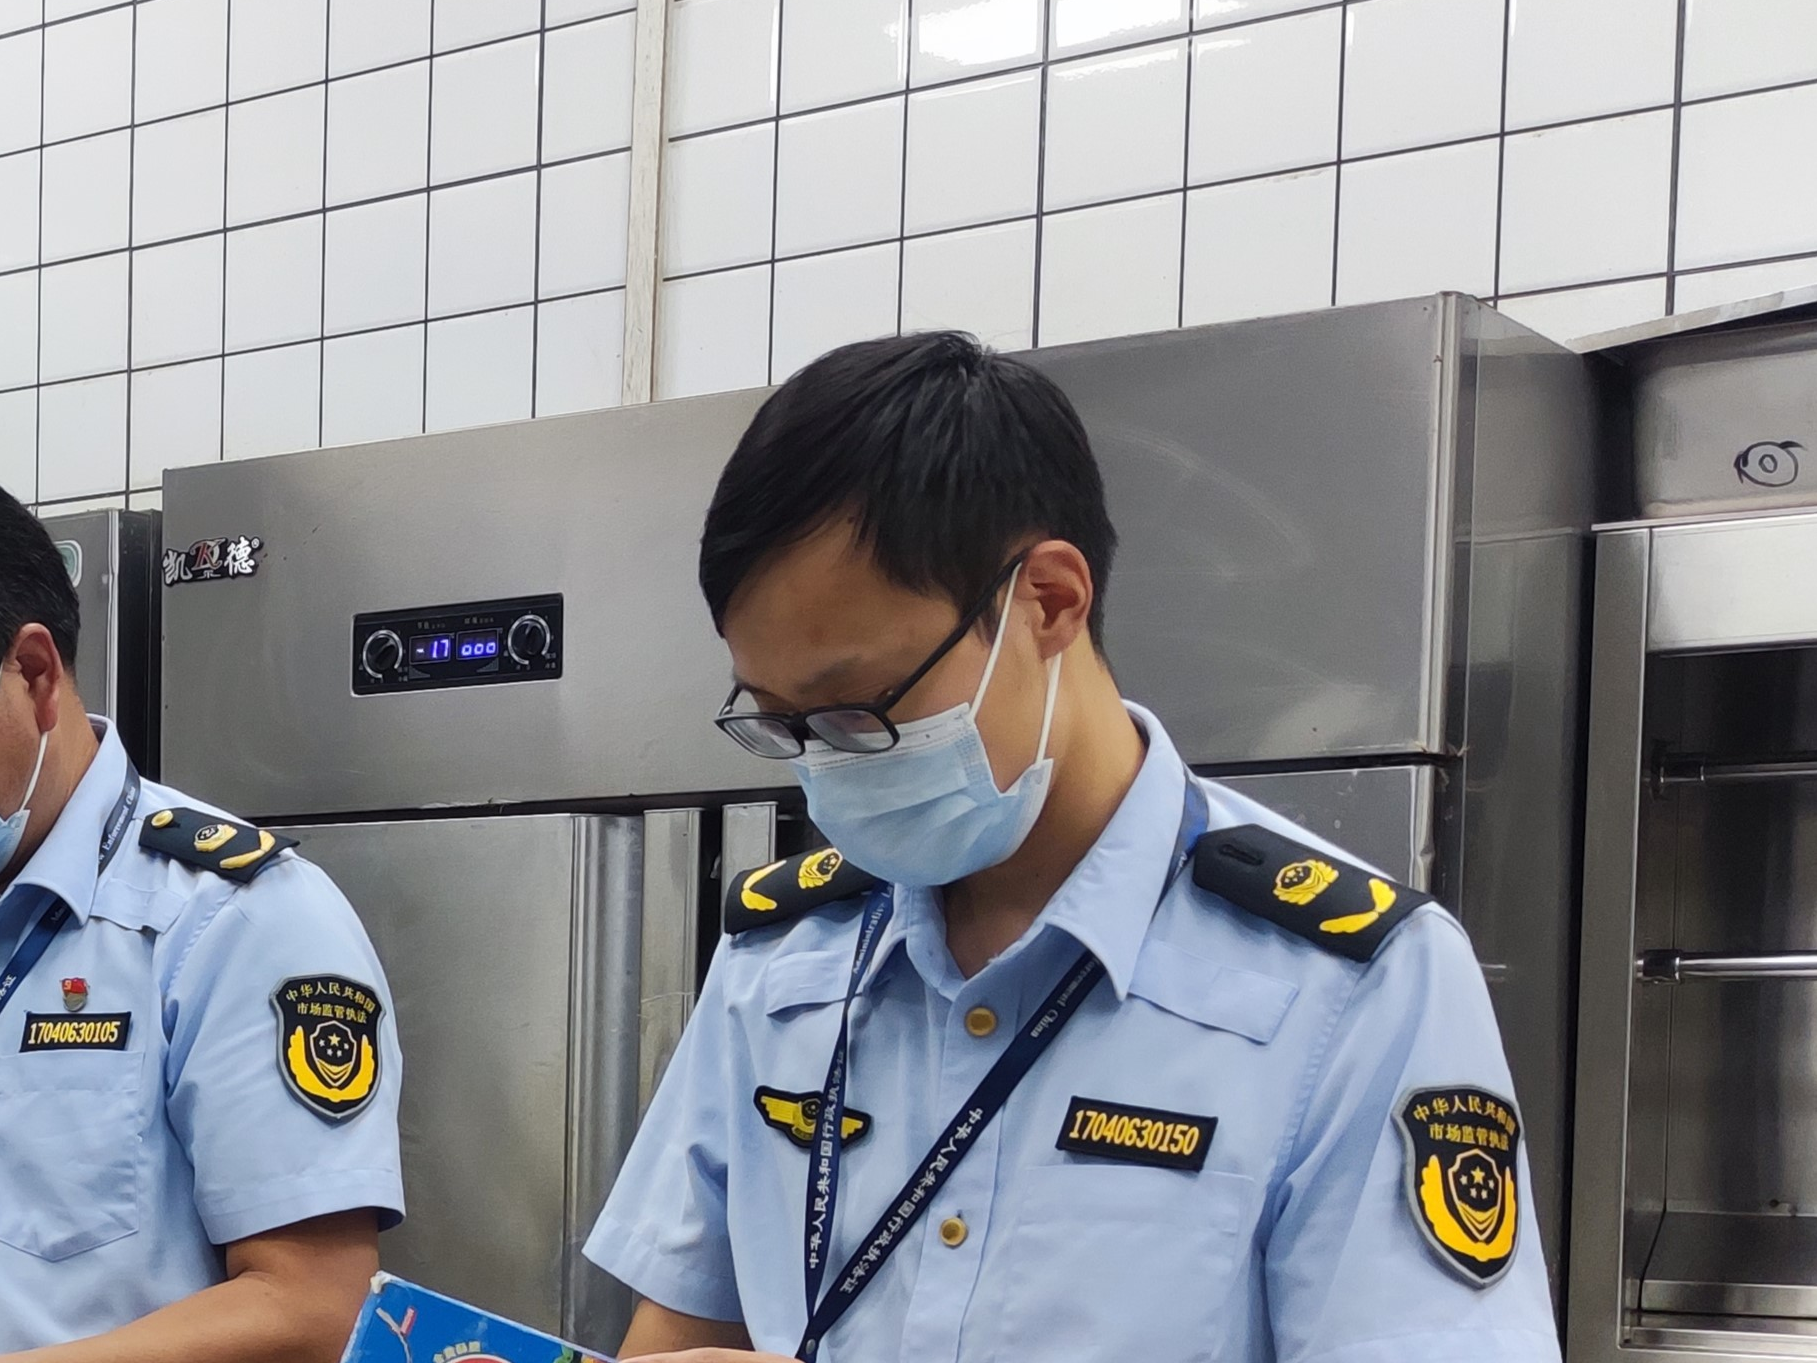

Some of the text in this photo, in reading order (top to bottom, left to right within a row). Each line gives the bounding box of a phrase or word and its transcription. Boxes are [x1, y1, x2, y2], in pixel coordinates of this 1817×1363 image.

[285, 980, 376, 1014] 中华人民共和国
[296, 1001, 368, 1025] 市场监管执法
[27, 1020, 122, 1045] 17040630105
[1068, 1109, 1200, 1156] 17040630150
[1412, 1094, 1517, 1137] 中华人民共和国
[1428, 1122, 1510, 1152] 市场监管执法
[808, 1050, 844, 1269] 中华人民共和国行政执法证
[839, 1107, 984, 1294] 中华人民共和国行政执法证
